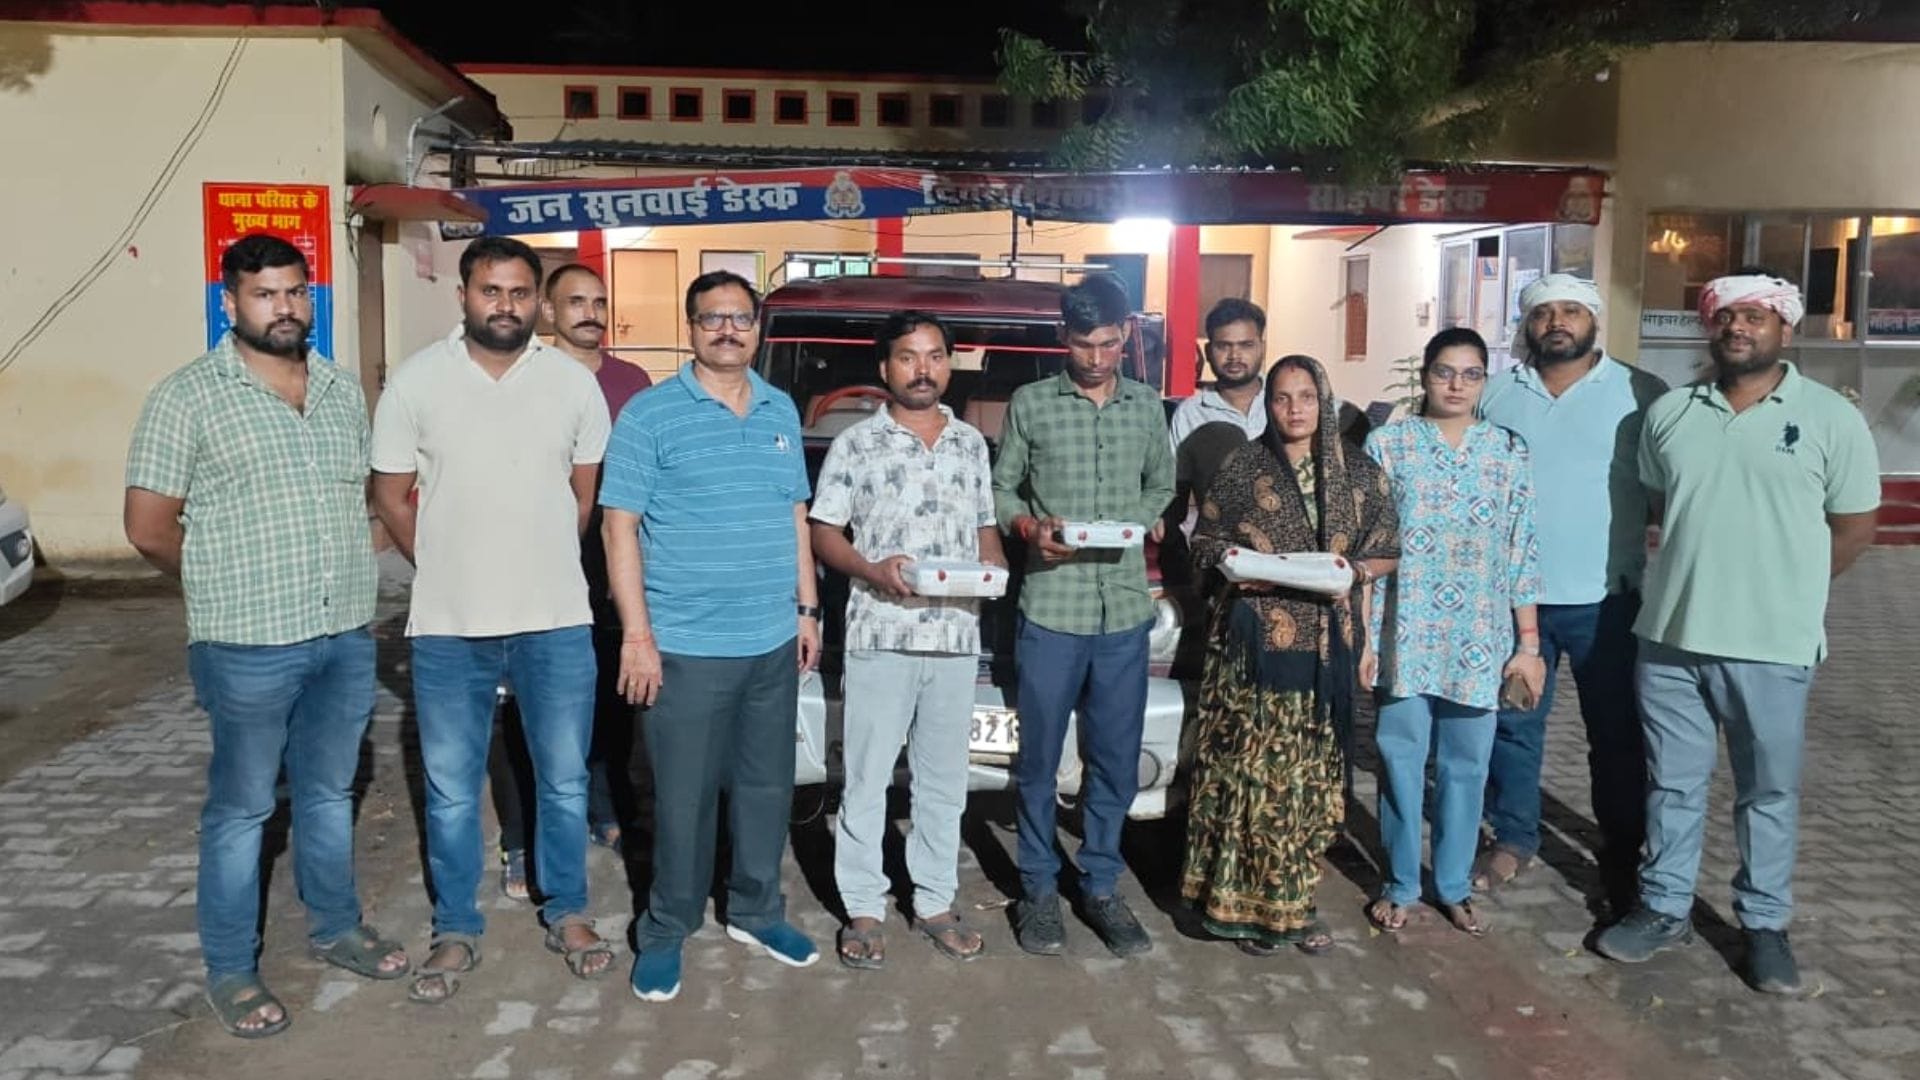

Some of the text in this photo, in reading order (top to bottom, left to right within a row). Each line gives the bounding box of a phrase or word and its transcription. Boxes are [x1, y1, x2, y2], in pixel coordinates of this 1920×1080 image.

[217, 189, 319, 209] थाना परिसर के
[500, 175, 802, 227] जन सुनवाई डेस्क
[231, 212, 302, 233] मुख्य भाग
